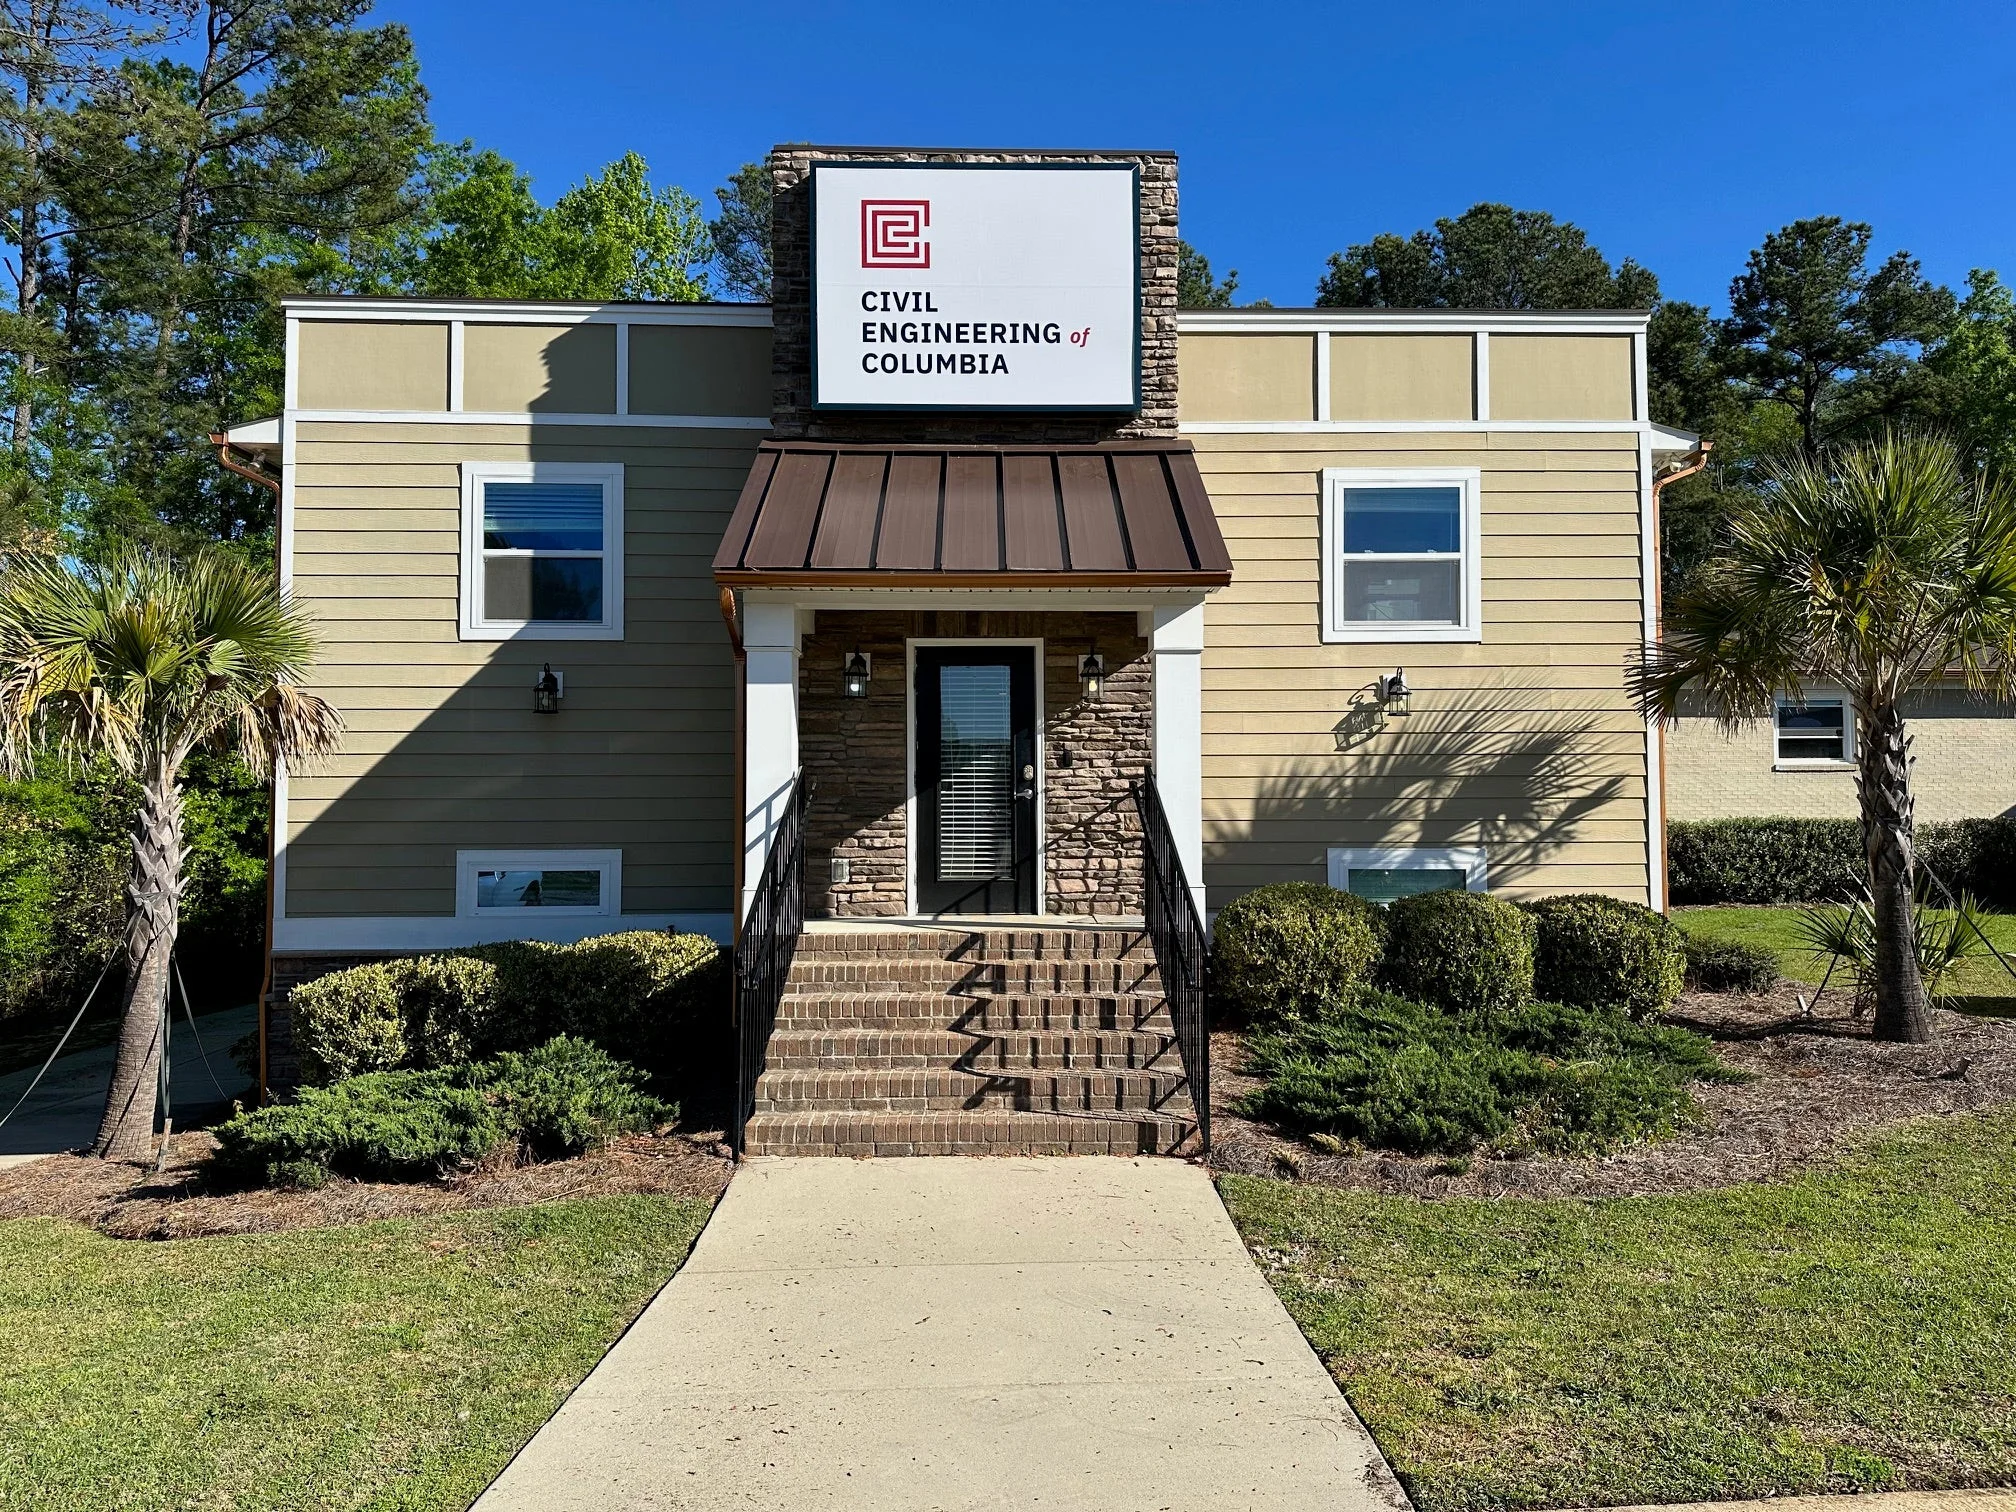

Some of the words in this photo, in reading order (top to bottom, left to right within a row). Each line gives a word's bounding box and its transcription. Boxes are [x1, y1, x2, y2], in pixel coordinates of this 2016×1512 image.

[862, 291, 938, 312] CIVIL
[863, 322, 1060, 343] ENGINEERING
[1070, 327, 1090, 347] of
[862, 353, 1009, 374] COLUMBIA
